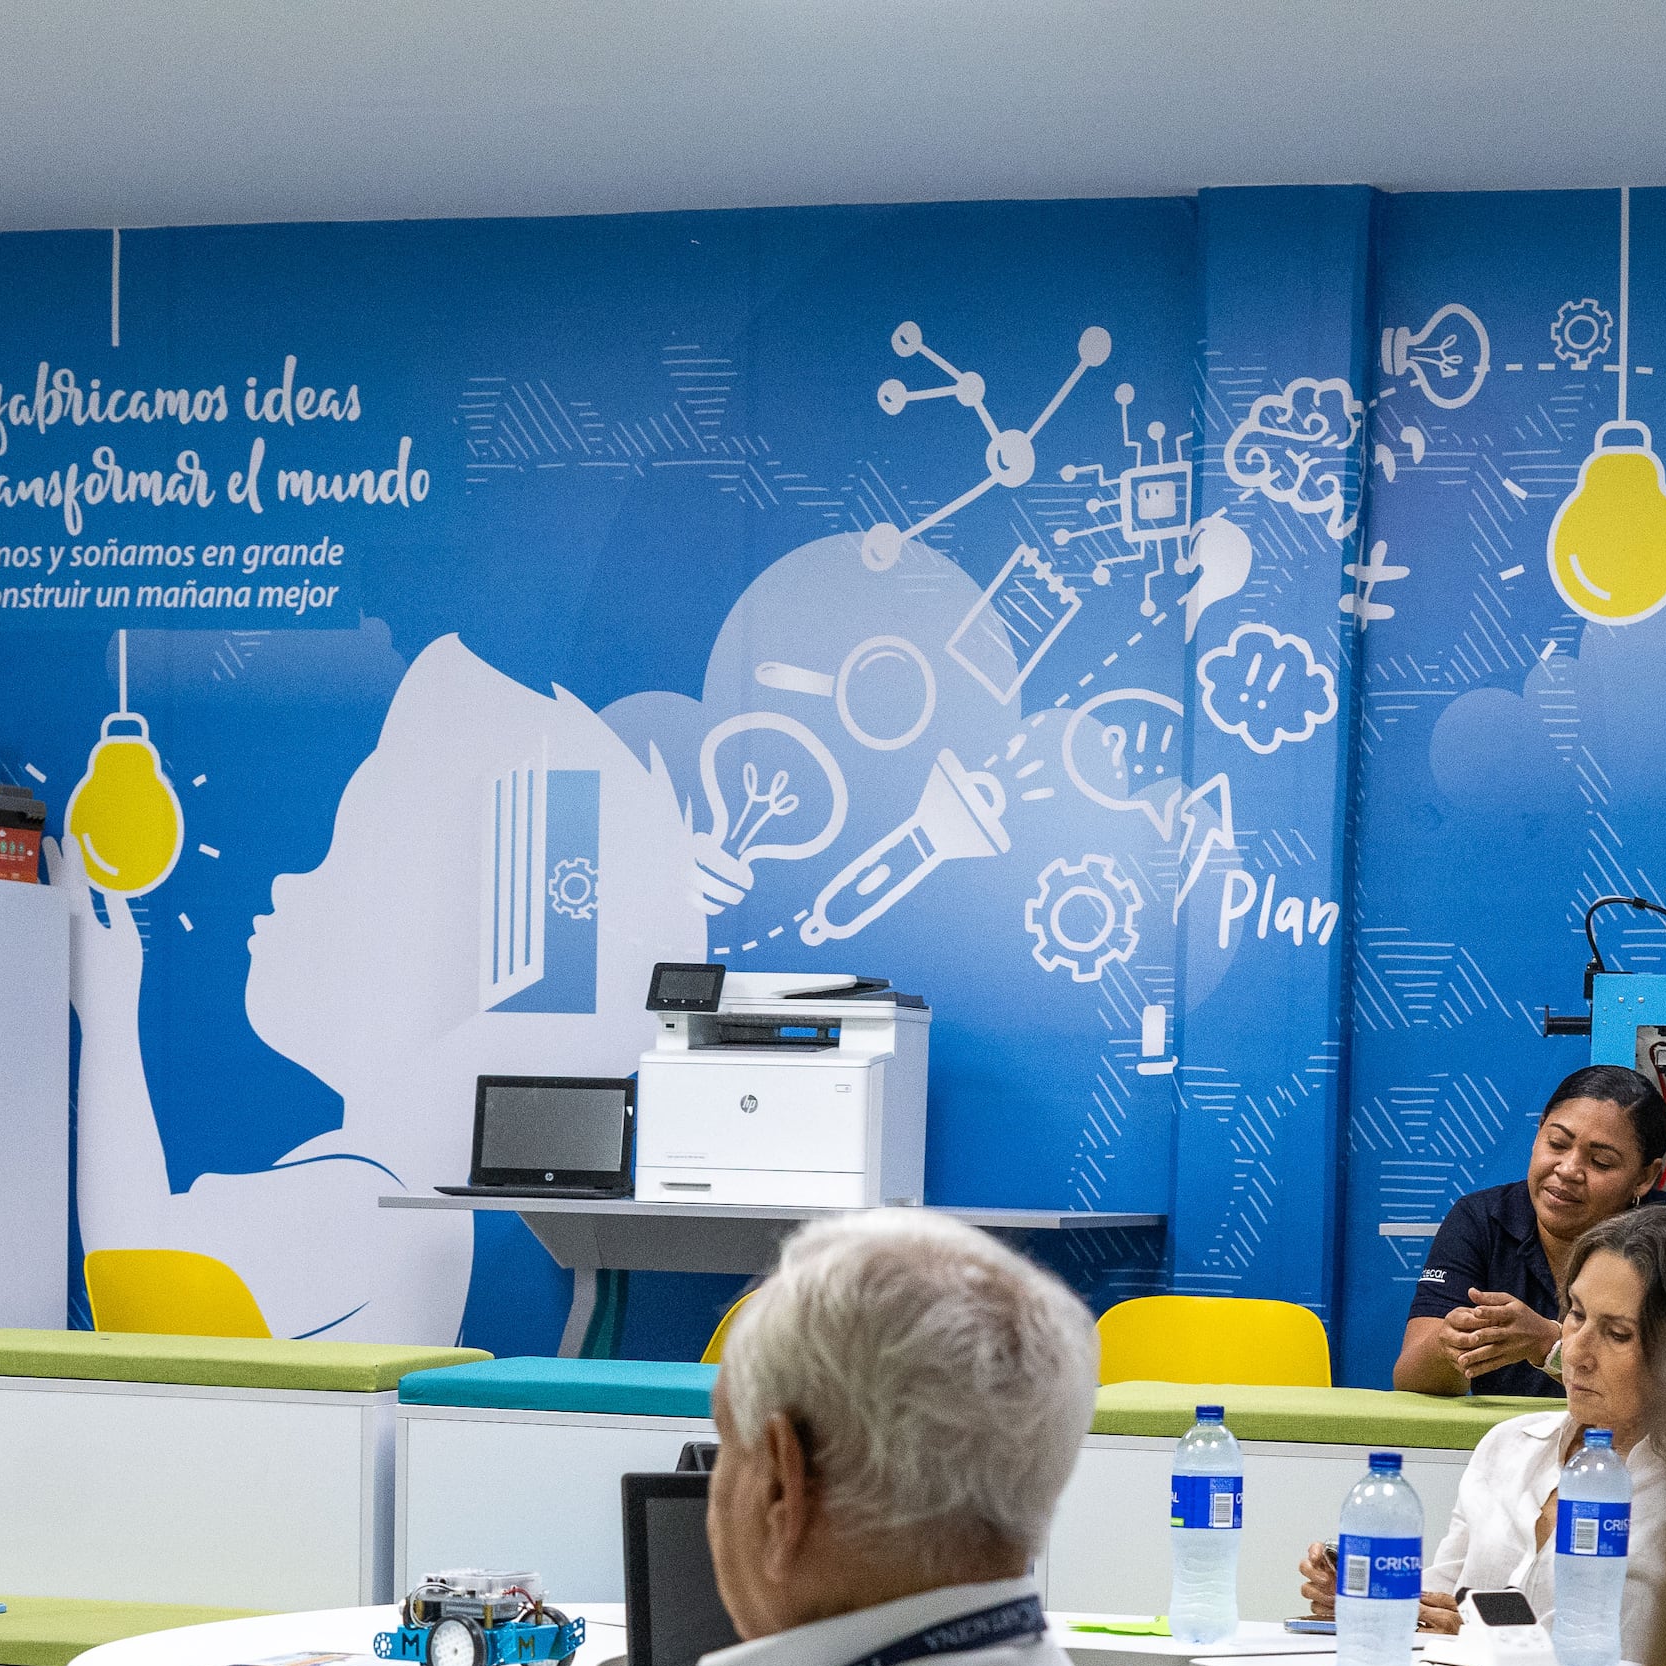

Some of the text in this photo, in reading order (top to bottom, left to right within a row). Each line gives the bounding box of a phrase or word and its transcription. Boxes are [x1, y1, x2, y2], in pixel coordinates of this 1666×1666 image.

[244, 355, 361, 426] ideas
[228, 437, 265, 513] el
[278, 436, 430, 508] mundo
[48, 547, 65, 576] y
[70, 538, 195, 567] soñamos
[202, 545, 236, 567] en
[243, 536, 345, 574] grande
[96, 587, 130, 609] un
[136, 580, 252, 609] mañana
[258, 579, 340, 616] mejor
[1218, 869, 1340, 950] Plan
[740, 1094, 758, 1113] hp
